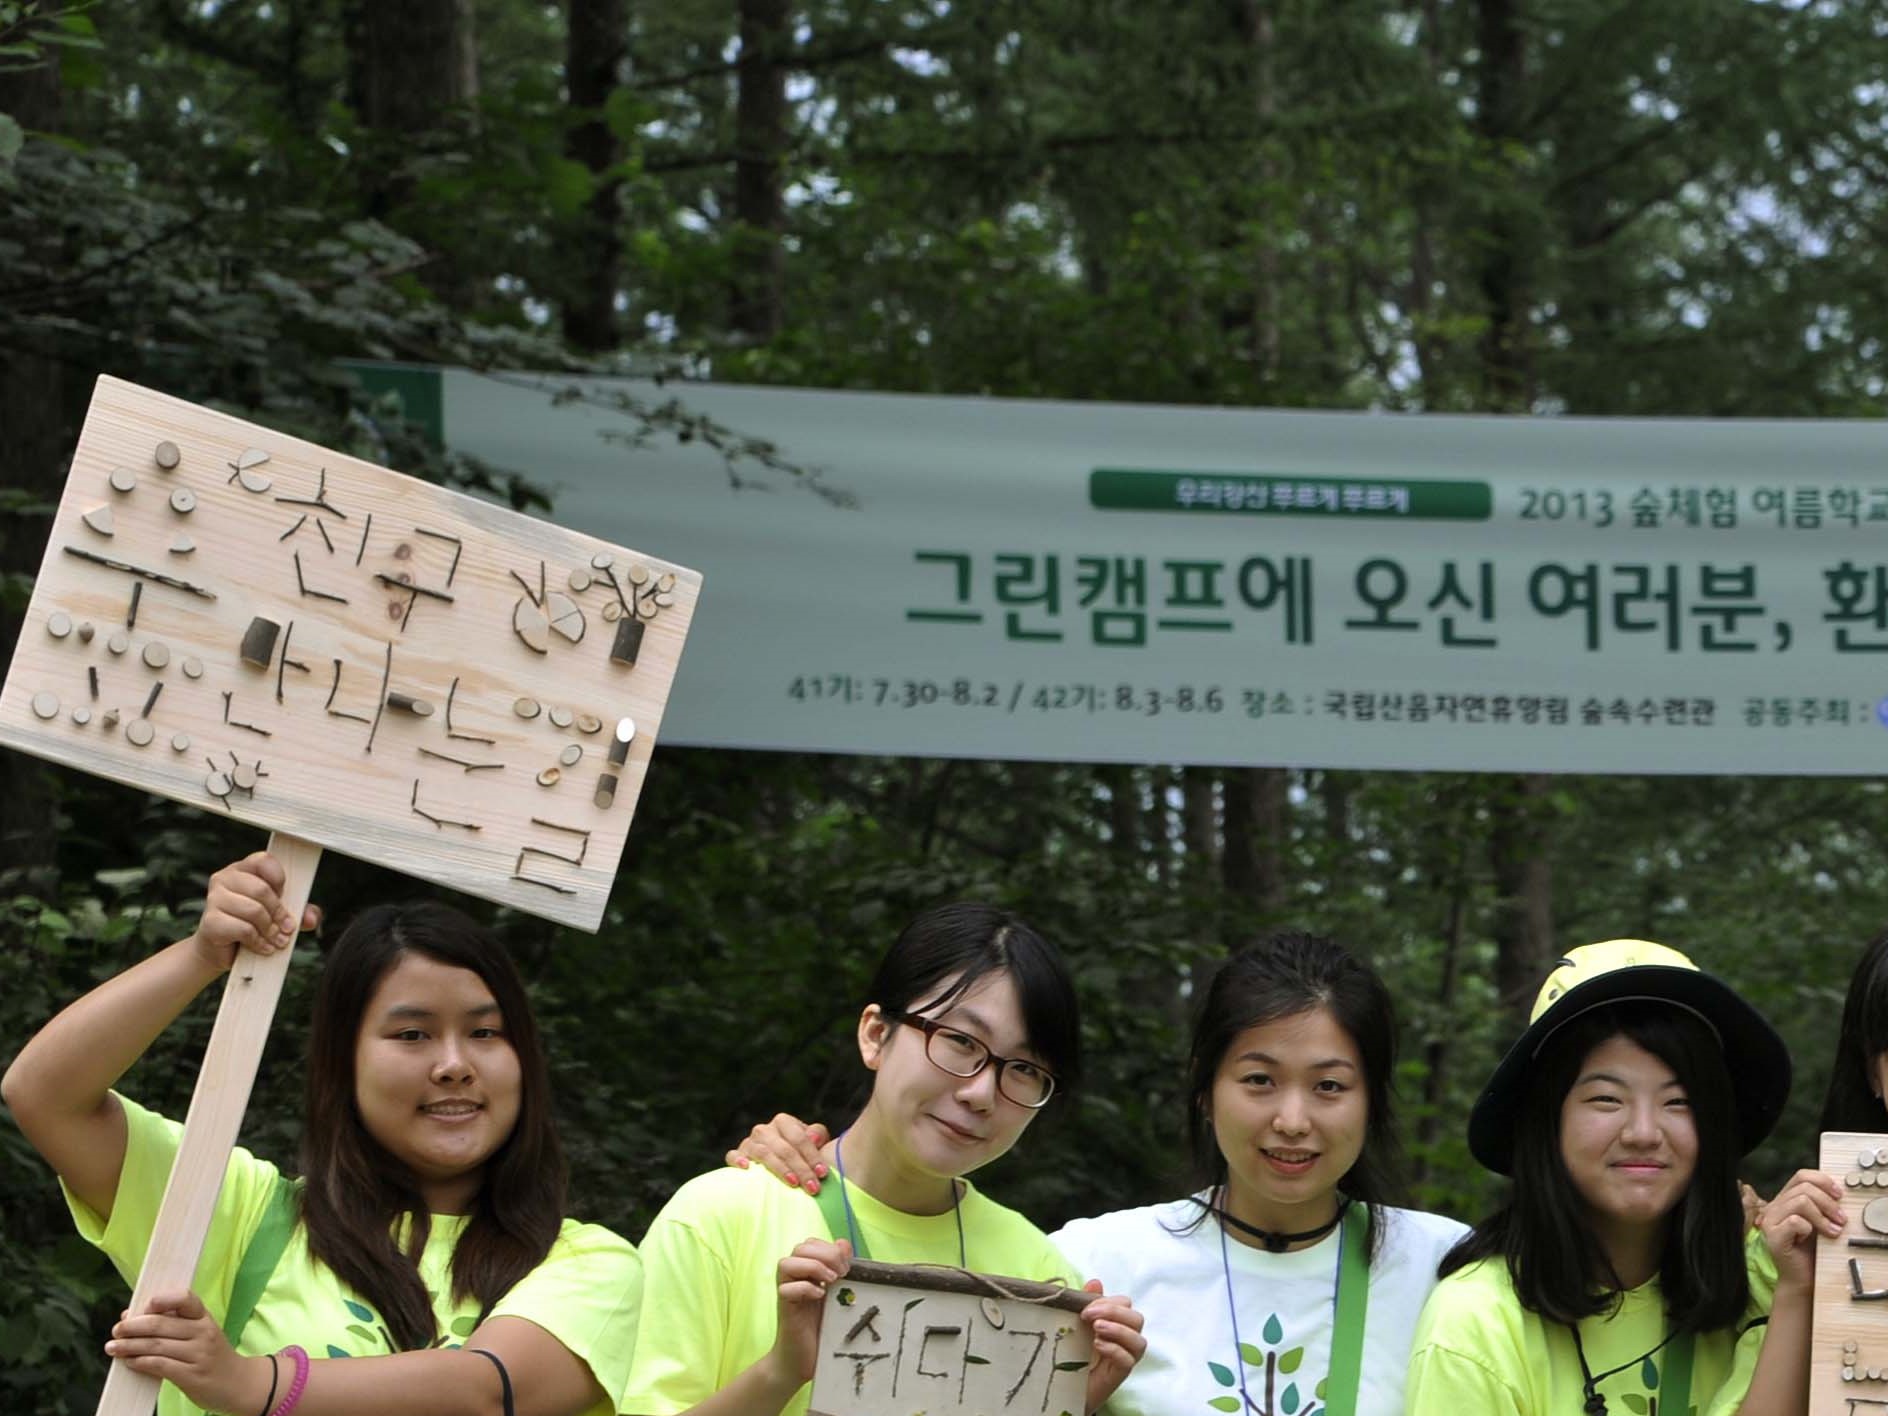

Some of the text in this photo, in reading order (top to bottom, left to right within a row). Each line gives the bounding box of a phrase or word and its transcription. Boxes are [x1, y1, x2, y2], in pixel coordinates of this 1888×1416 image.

[1518, 488, 1615, 526] 2013
[1629, 486, 1740, 529] 숲체험
[905, 550, 1314, 648] 그린캠프에
[1344, 556, 1499, 650] 오신
[1527, 562, 1794, 654] 여러분,
[871, 678, 999, 711] 7.30-8.2
[1114, 685, 1223, 717] 8.3-8.6
[1242, 688, 1296, 719] 장소
[1744, 697, 1852, 728] 공동주최
